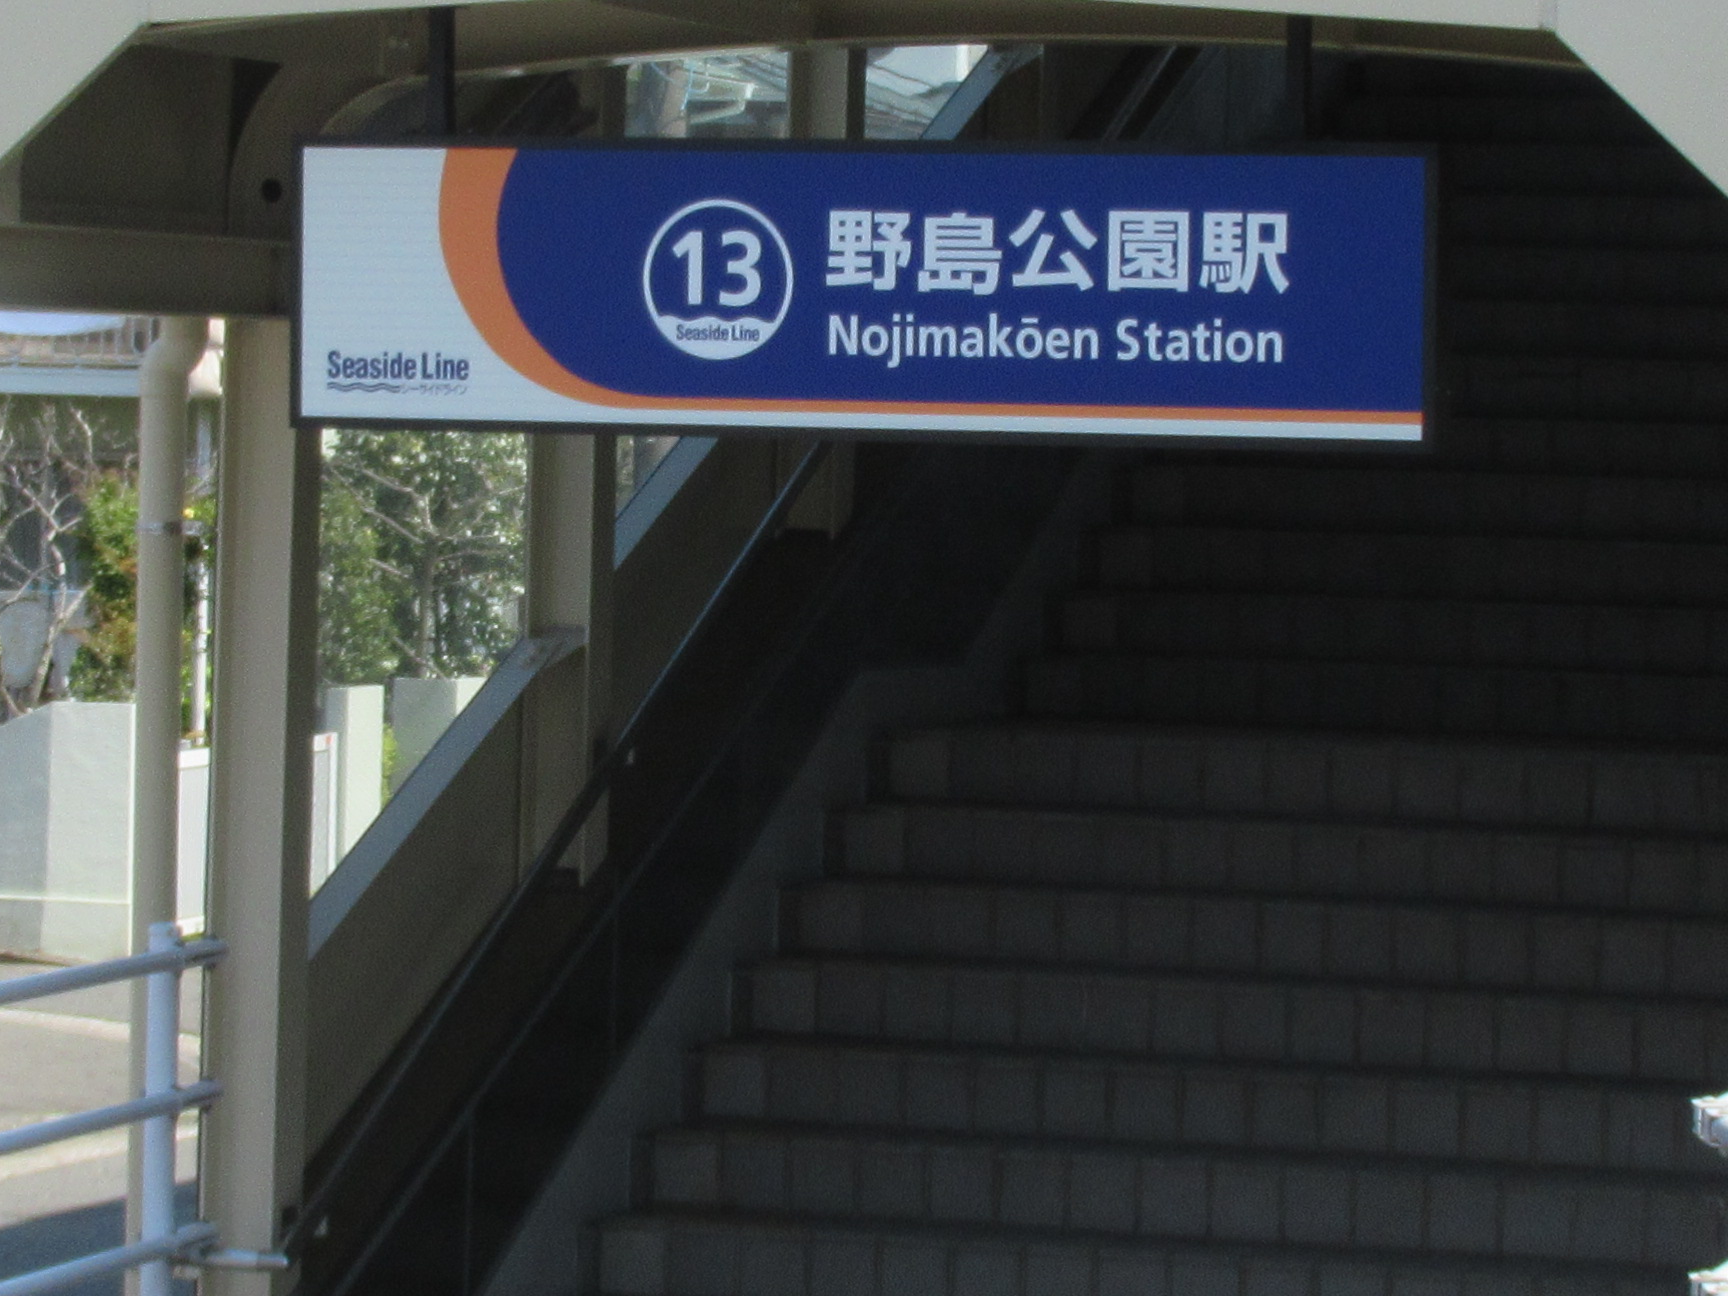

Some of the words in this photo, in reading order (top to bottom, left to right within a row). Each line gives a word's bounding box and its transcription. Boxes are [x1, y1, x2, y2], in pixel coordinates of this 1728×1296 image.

[672, 230, 762, 307] 13
[826, 209, 1290, 295] 野島公園駅
[676, 324, 729, 342] Seaside
[731, 325, 761, 342] Line
[828, 313, 1099, 369] Nojimakōen
[1116, 317, 1284, 364] Station
[327, 349, 417, 380] Seaside
[421, 351, 470, 381] Line
